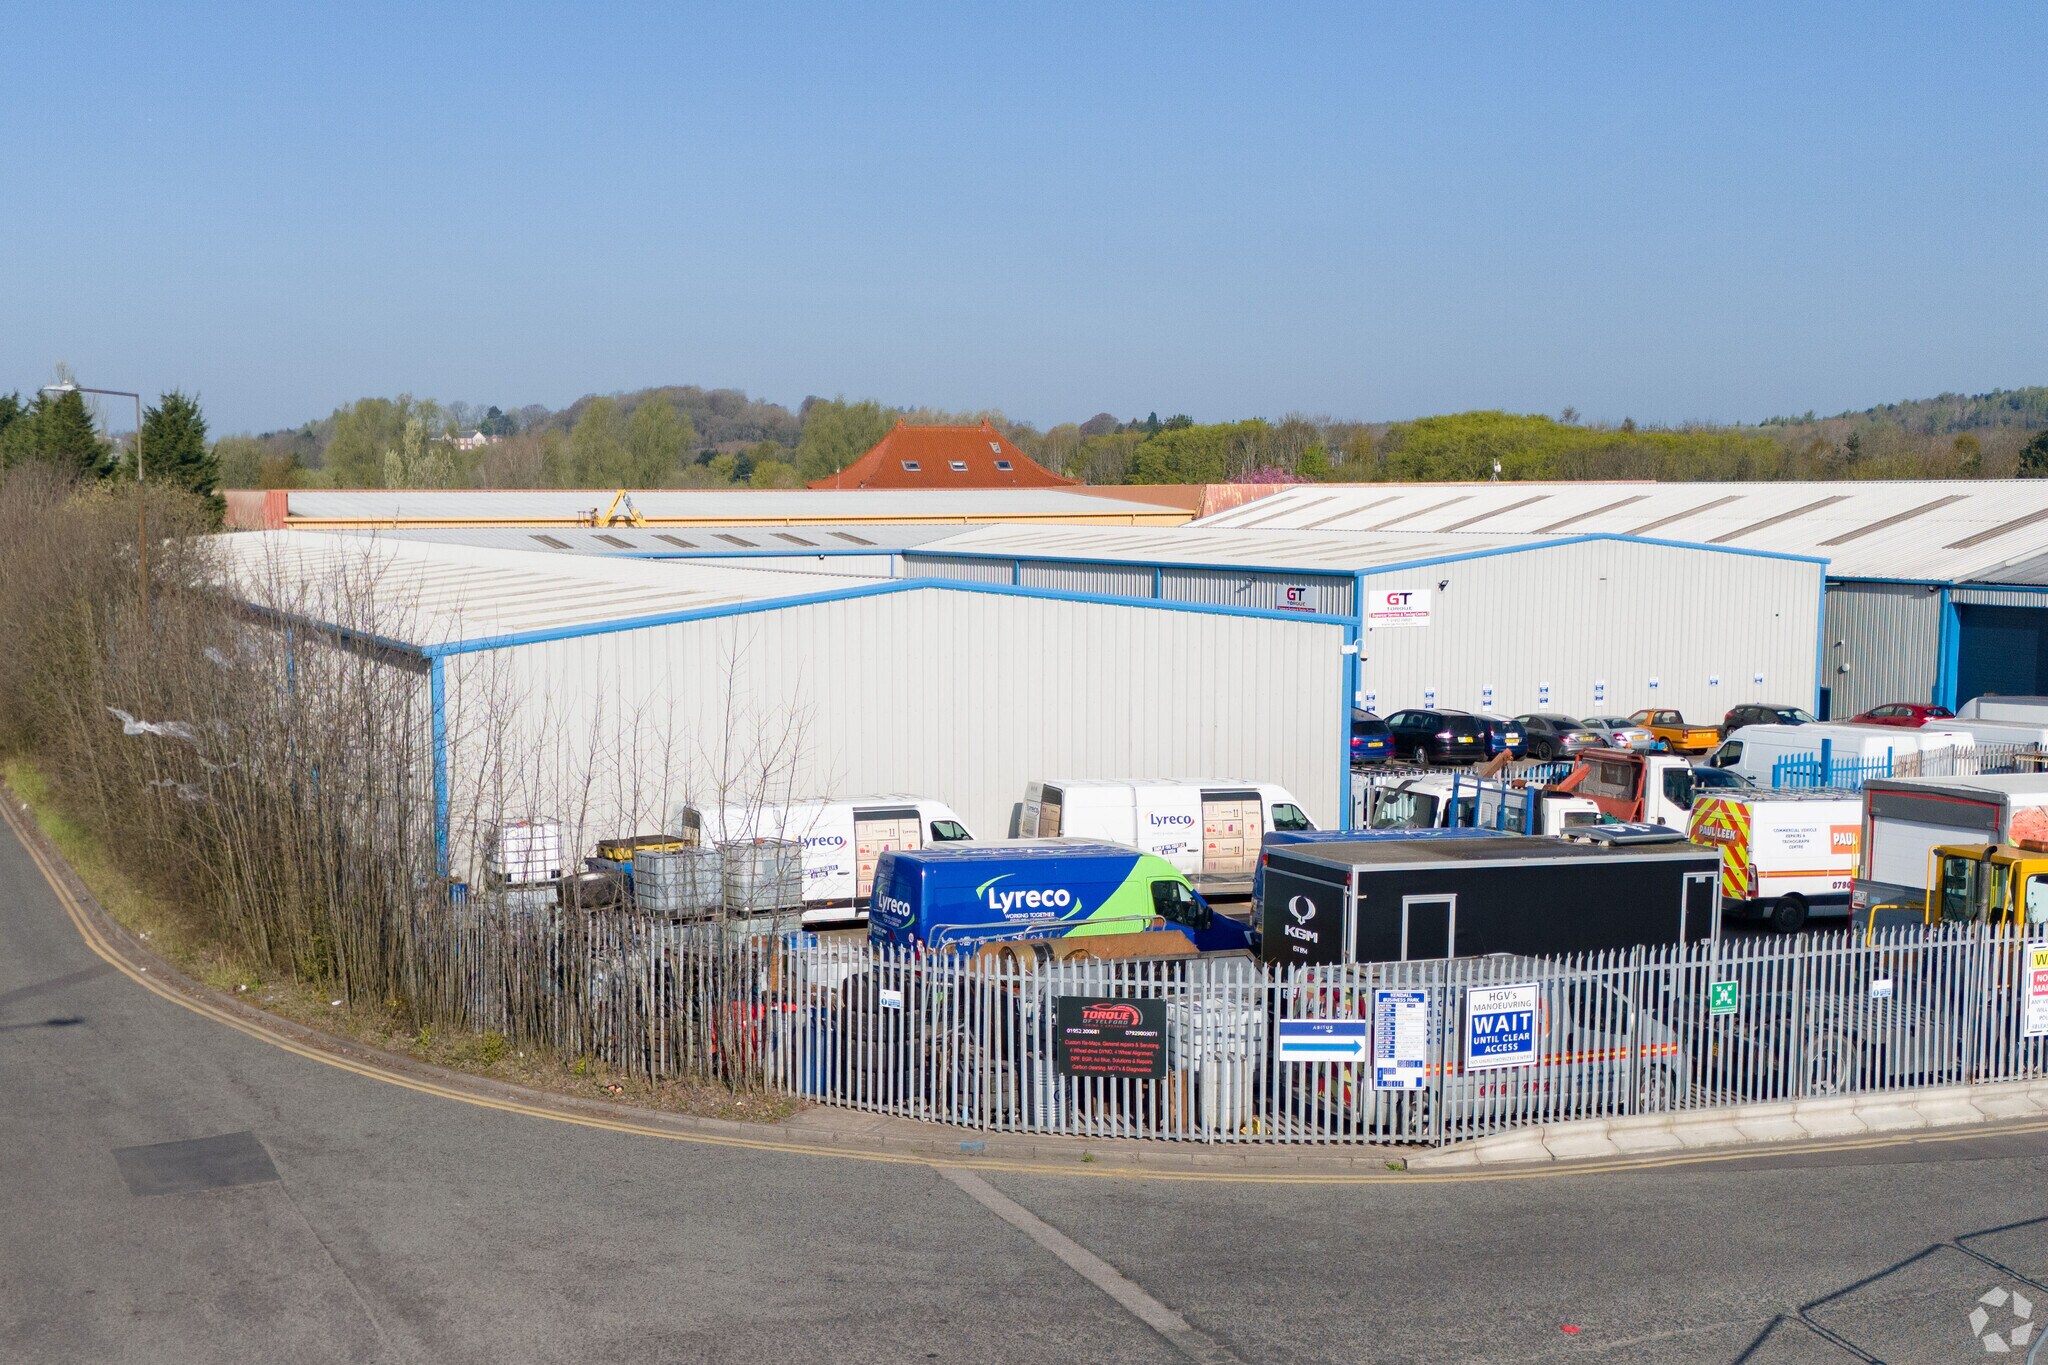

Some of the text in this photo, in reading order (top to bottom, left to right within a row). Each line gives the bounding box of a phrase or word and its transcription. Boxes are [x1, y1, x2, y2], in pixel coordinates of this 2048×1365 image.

[1287, 588, 1306, 601] GT
[1386, 592, 1412, 605] GT
[1150, 813, 1192, 827] Lyreco
[1698, 825, 1736, 840] PAUL LEEK
[797, 835, 844, 849] Lyreco
[879, 890, 910, 916] Lyreco
[988, 887, 1070, 914] Lyreco
[1284, 925, 1318, 944] KGM
[2036, 954, 2048, 966] W
[1489, 991, 1517, 1001] HGV's
[1473, 1000, 1532, 1011] MANOEUVRING
[1082, 1011, 1130, 1020] TORQUE
[1474, 1013, 1531, 1034] WAIT
[1473, 1032, 1530, 1044] UNTIL CLEAR
[1484, 1043, 1518, 1053] ACCESS
